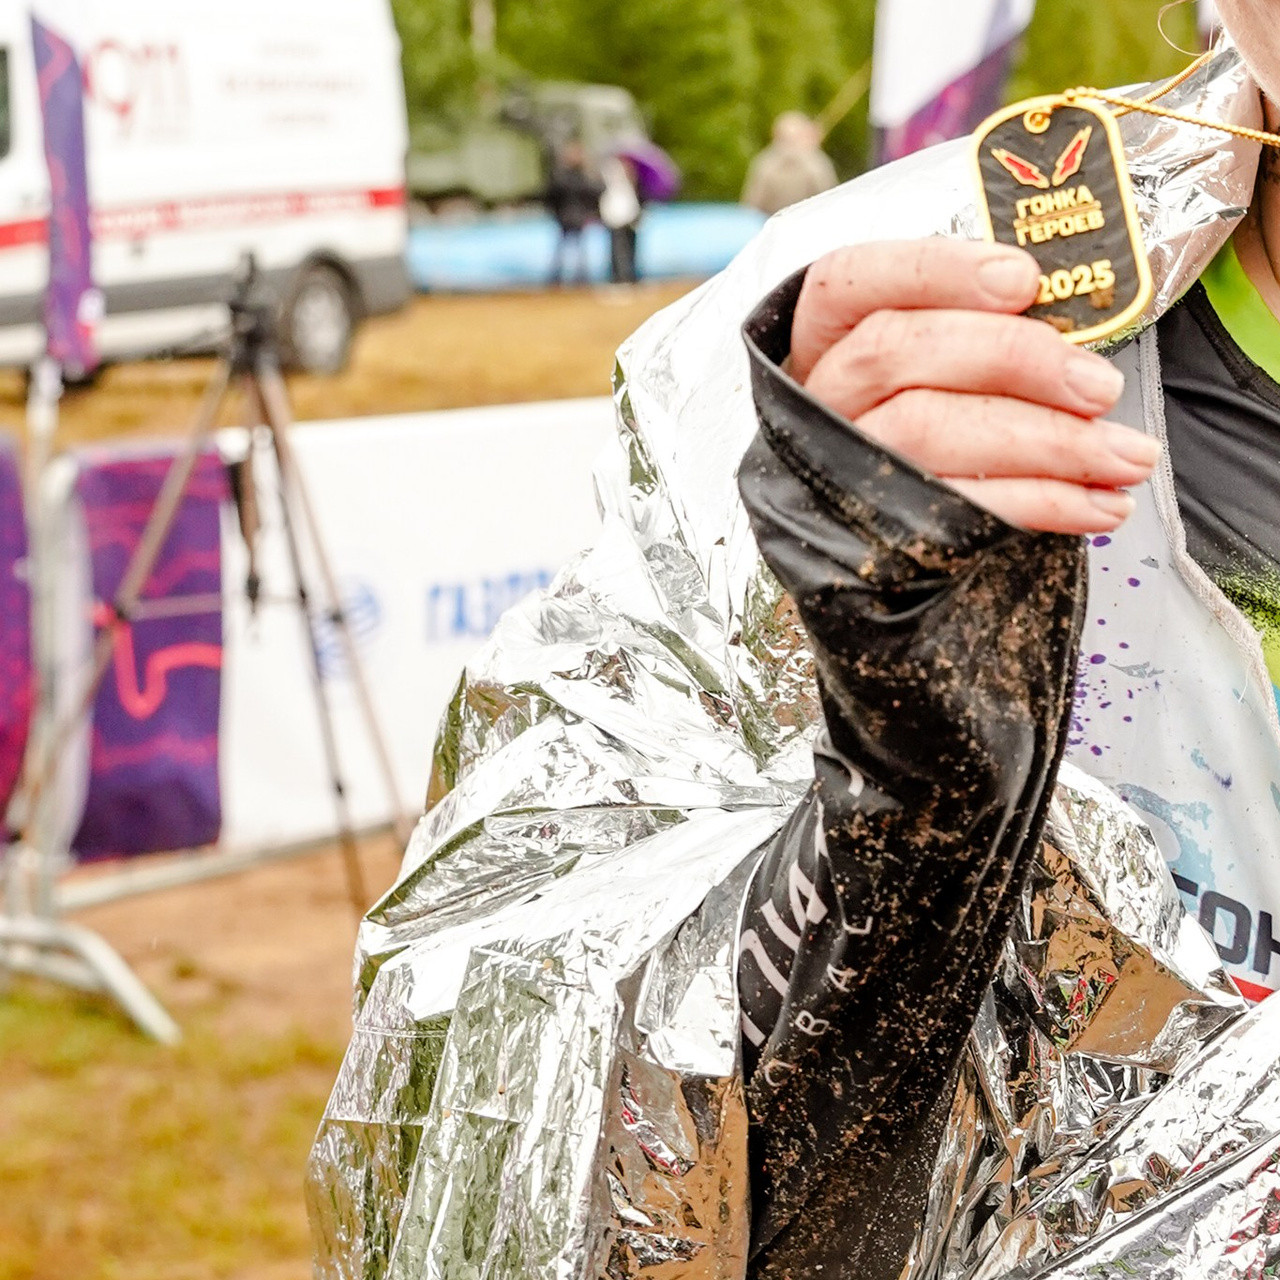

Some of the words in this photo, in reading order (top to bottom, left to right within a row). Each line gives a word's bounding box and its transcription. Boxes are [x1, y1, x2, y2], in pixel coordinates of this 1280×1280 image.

[1016, 185, 1095, 219] ГОНКА
[1015, 209, 1105, 246] ГЕРОЕВ
[1035, 259, 1116, 305] 2025
